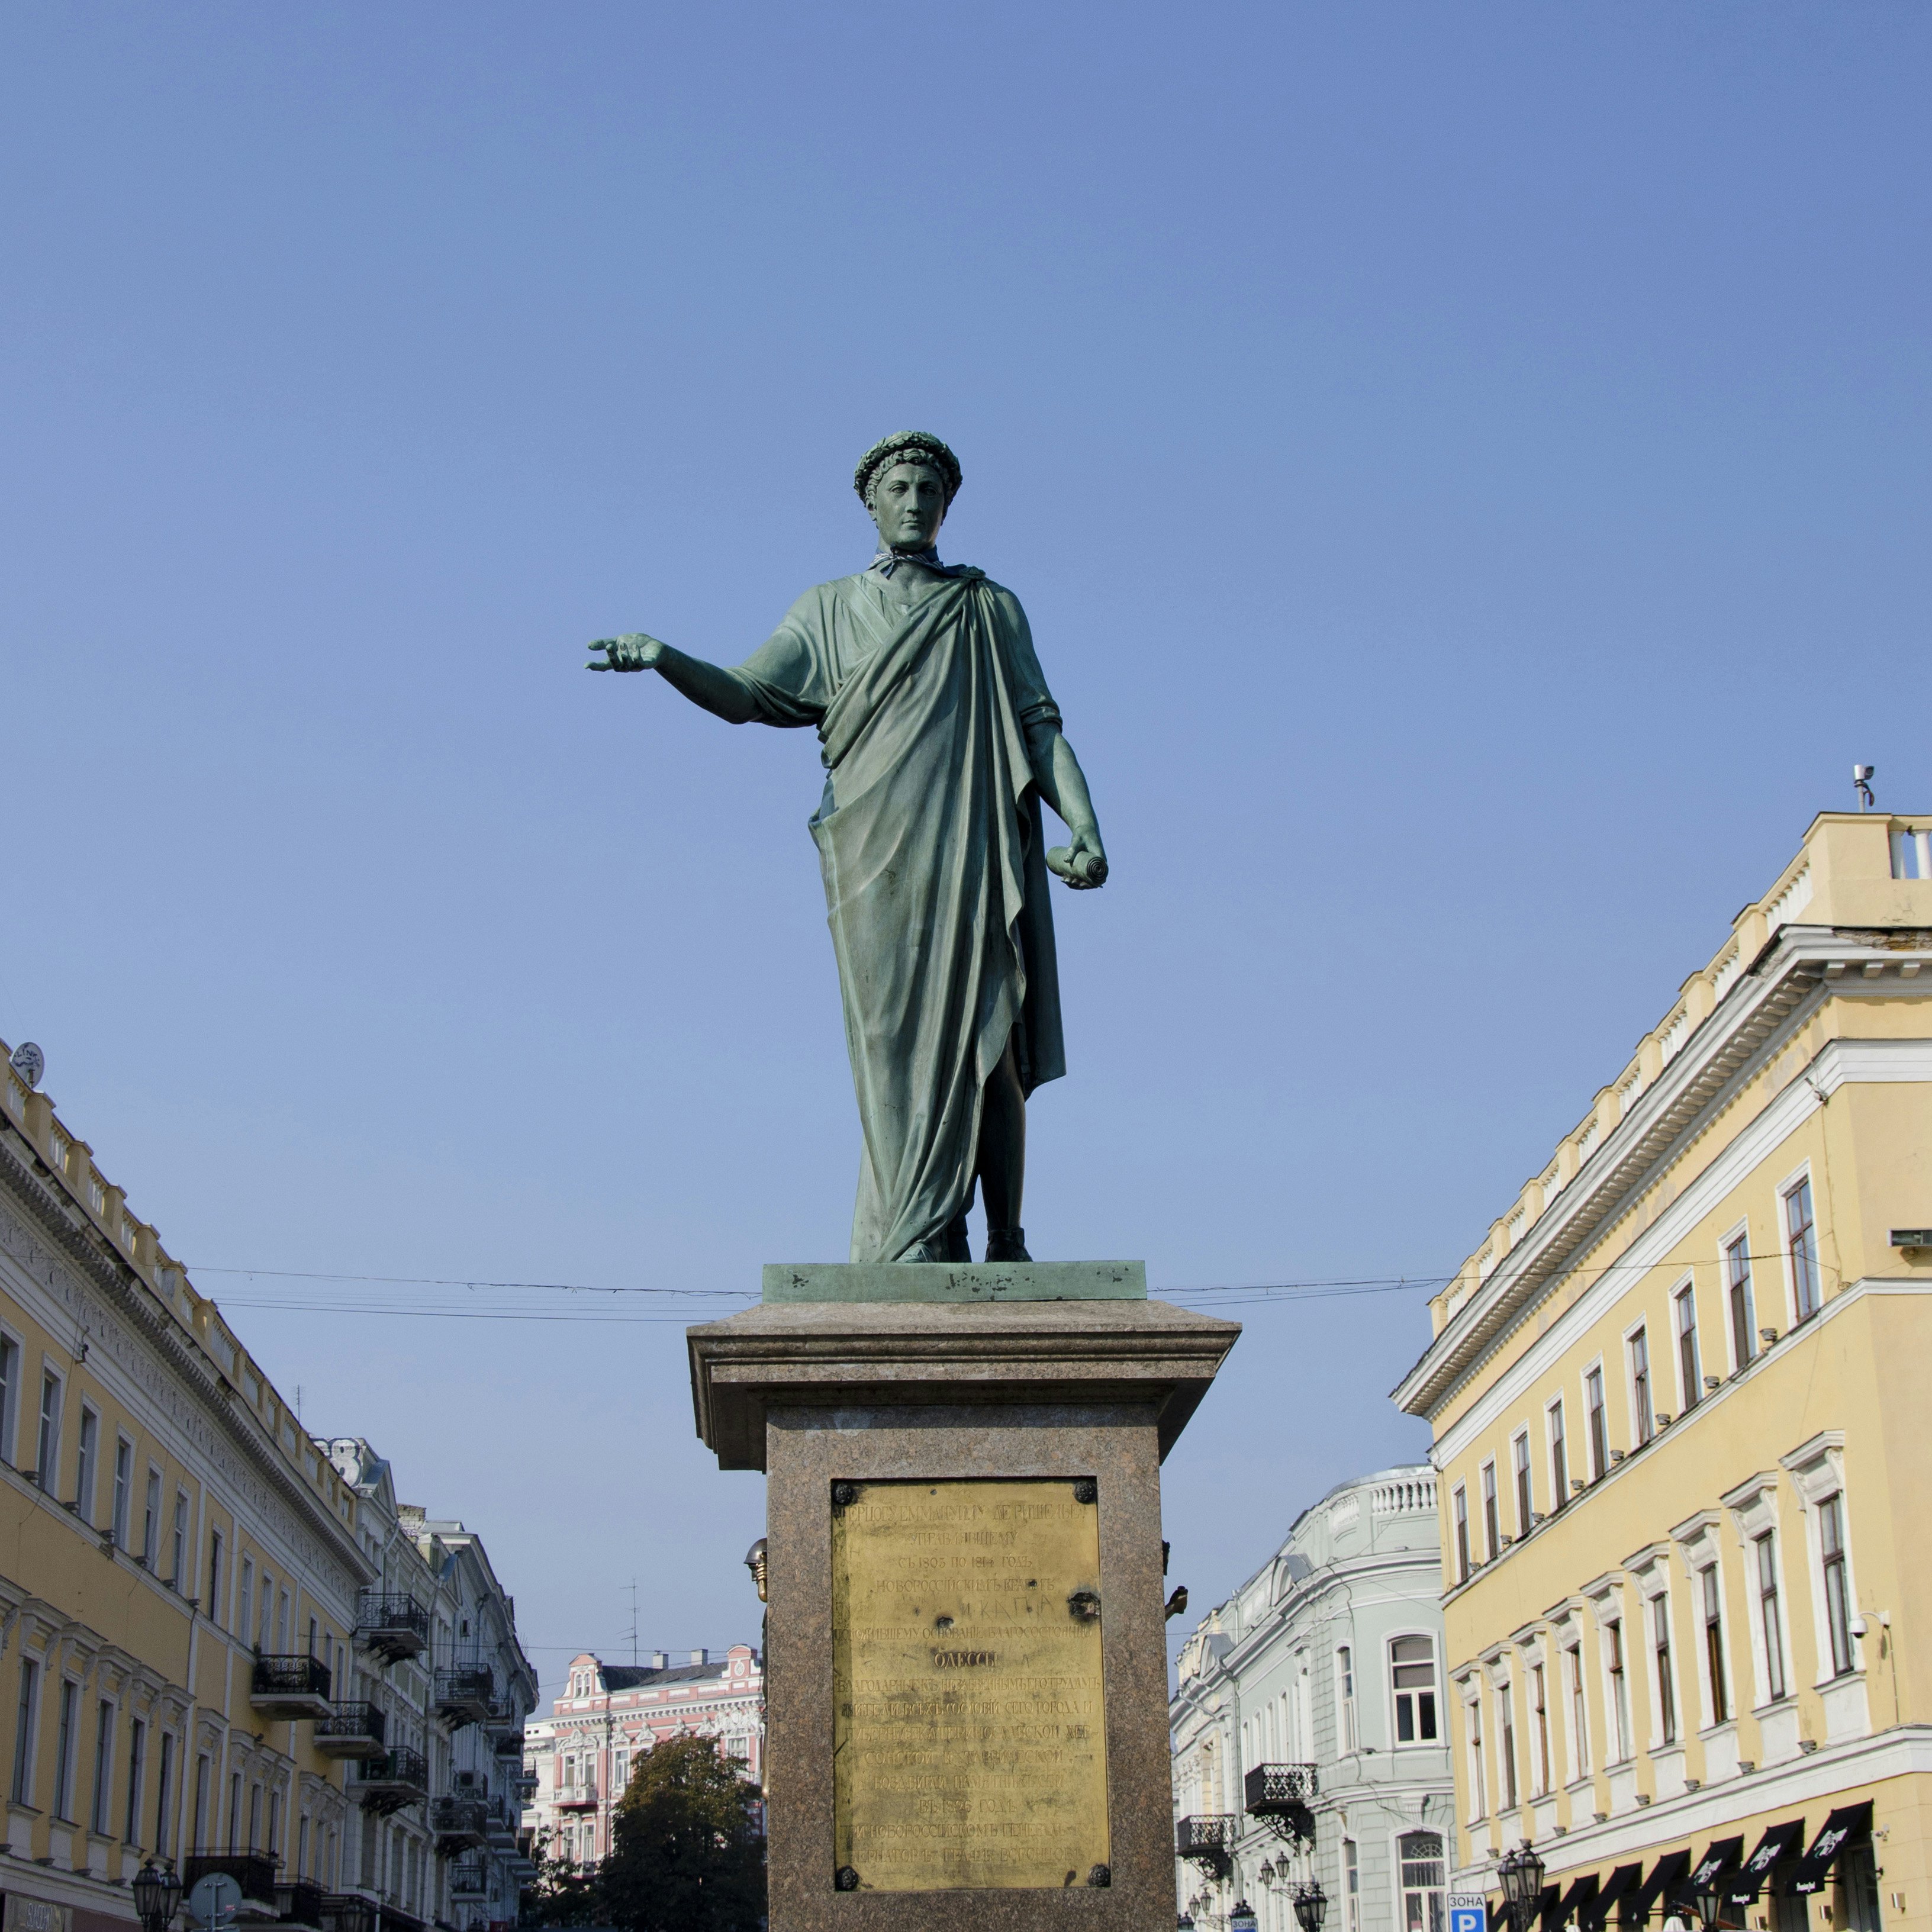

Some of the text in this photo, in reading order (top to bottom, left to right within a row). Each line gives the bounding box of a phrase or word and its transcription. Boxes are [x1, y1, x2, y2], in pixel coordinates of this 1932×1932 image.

[951, 1557, 967, 1568] ПО
[933, 1651, 998, 1669] ОДЕССЫ
[1450, 1896, 1483, 1907] ЗОНА
